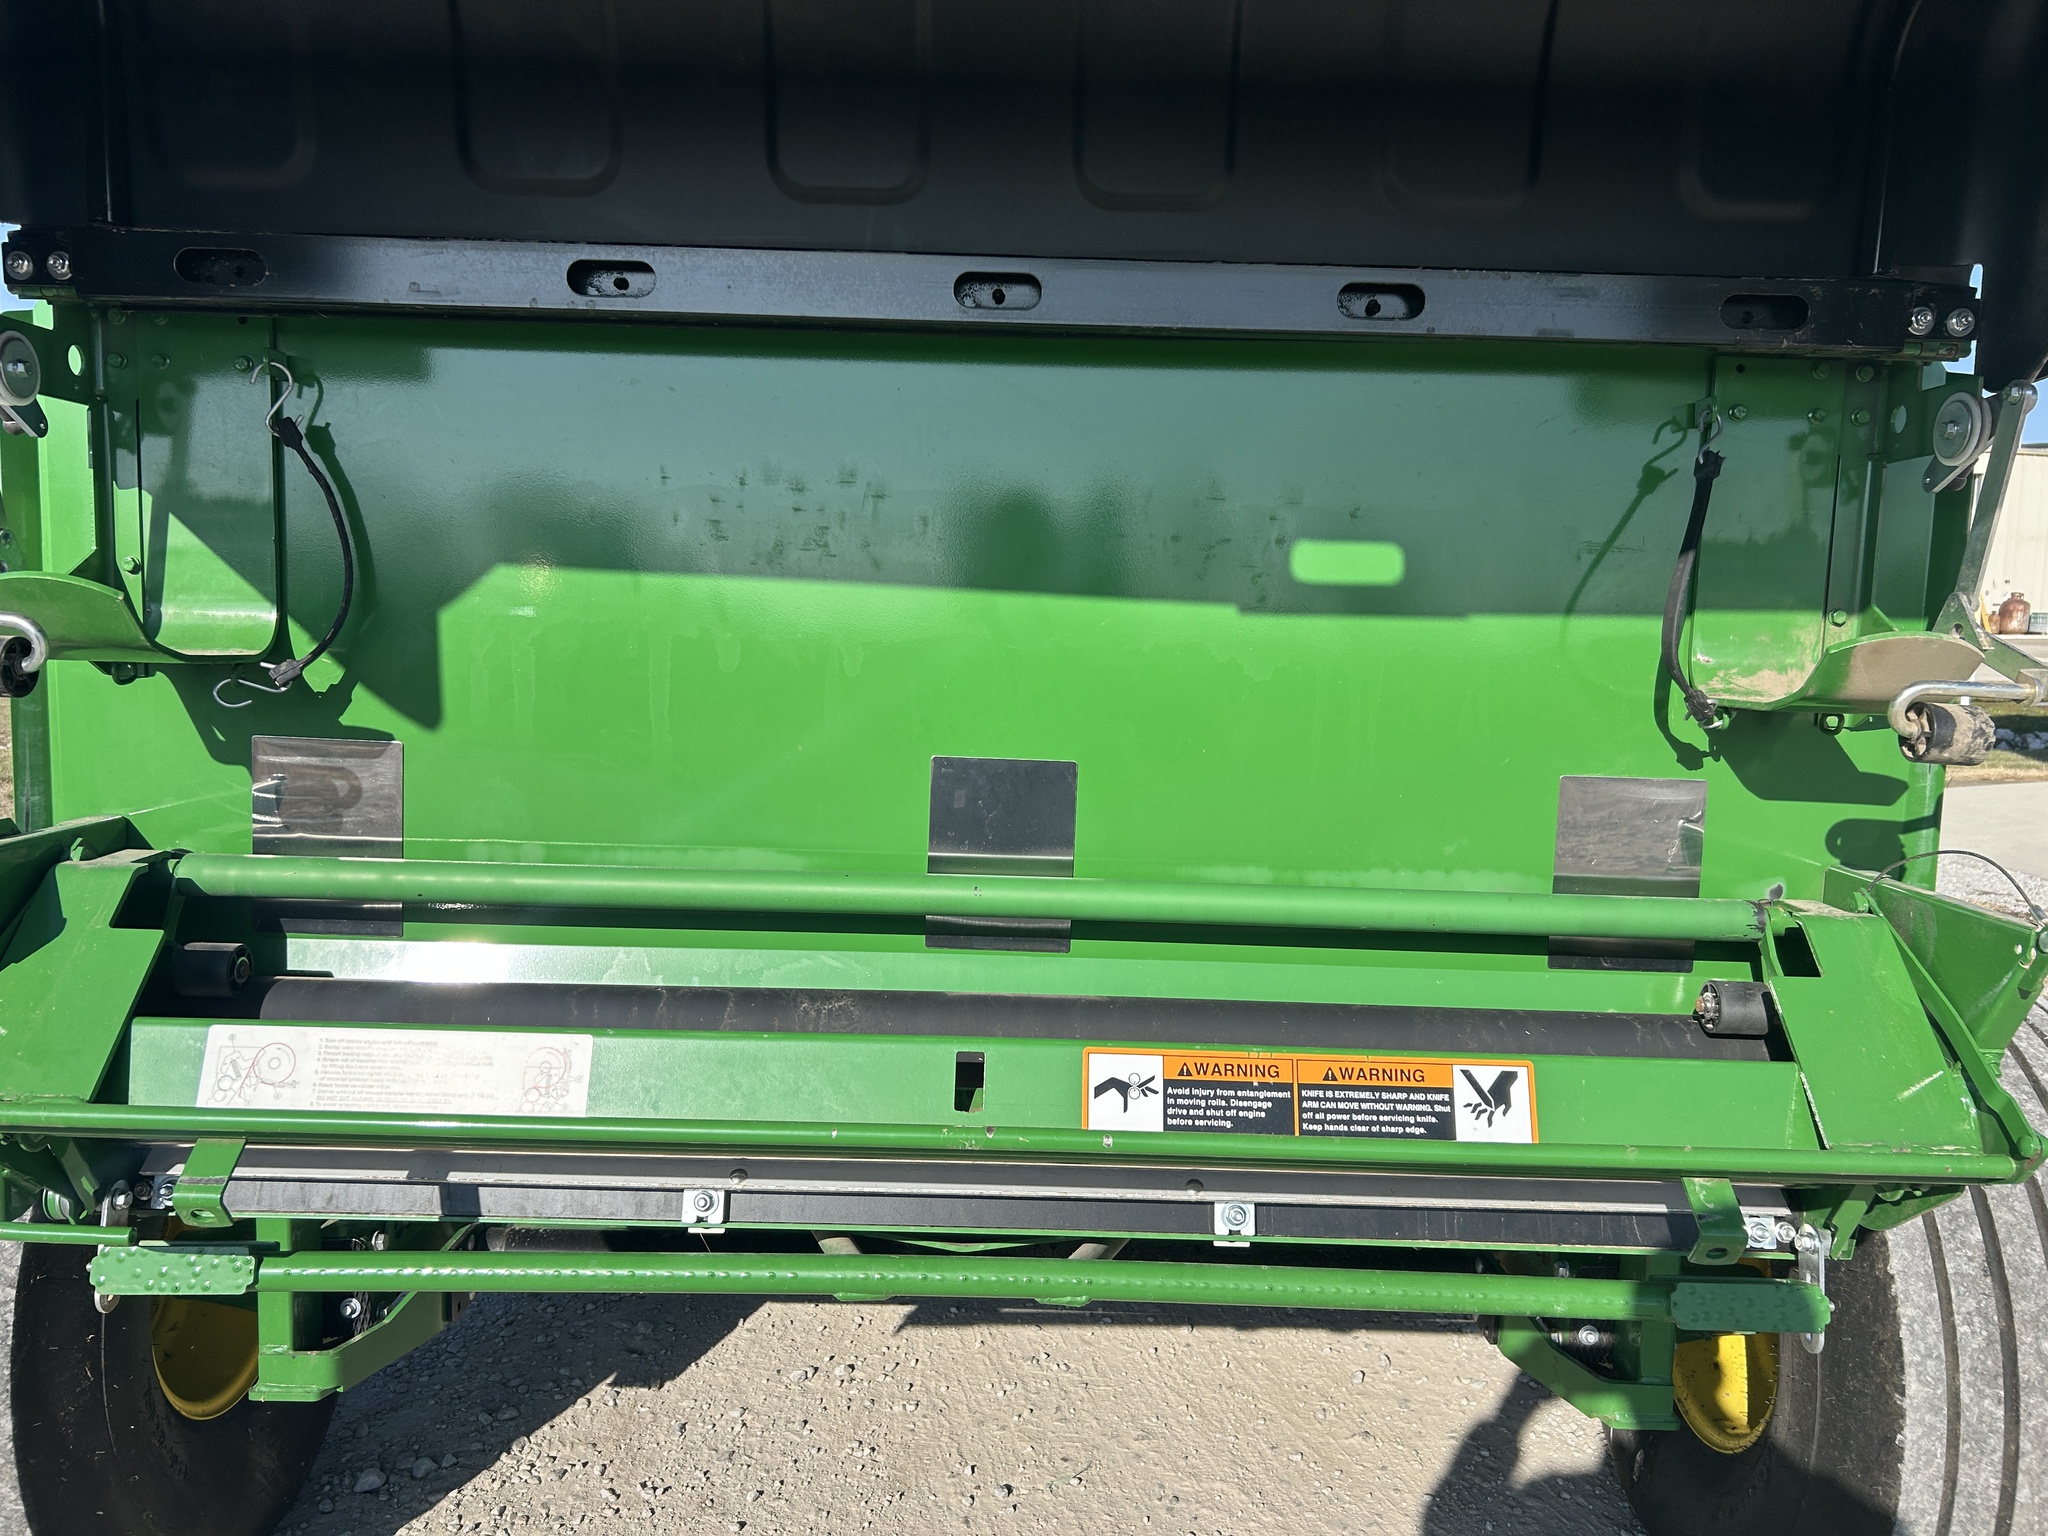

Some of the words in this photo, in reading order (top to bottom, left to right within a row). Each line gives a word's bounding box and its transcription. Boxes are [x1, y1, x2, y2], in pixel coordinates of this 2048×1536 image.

[1194, 1062, 1279, 1078] WARNING
[1339, 1067, 1425, 1082] WARNING
[1167, 1087, 1190, 1095] Avoid
[1192, 1088, 1214, 1097] injury
[1217, 1088, 1235, 1096] from
[1237, 1090, 1291, 1098] entanglement
[1335, 1091, 1380, 1099] EXTREMELY
[1177, 1098, 1205, 1107] moving
[1208, 1098, 1228, 1106] rolls.
[1231, 1099, 1272, 1109] Disengage
[1167, 1107, 1187, 1115] drive
[1189, 1108, 1204, 1116] and
[1195, 1119, 1233, 1128] servicing.
[1379, 1115, 1415, 1123] servicing
[1303, 1123, 1322, 1131] Keep
[1324, 1123, 1348, 1131] hands
[1381, 1125, 1403, 1134] sharp
[1406, 1126, 1426, 1134] edge.
